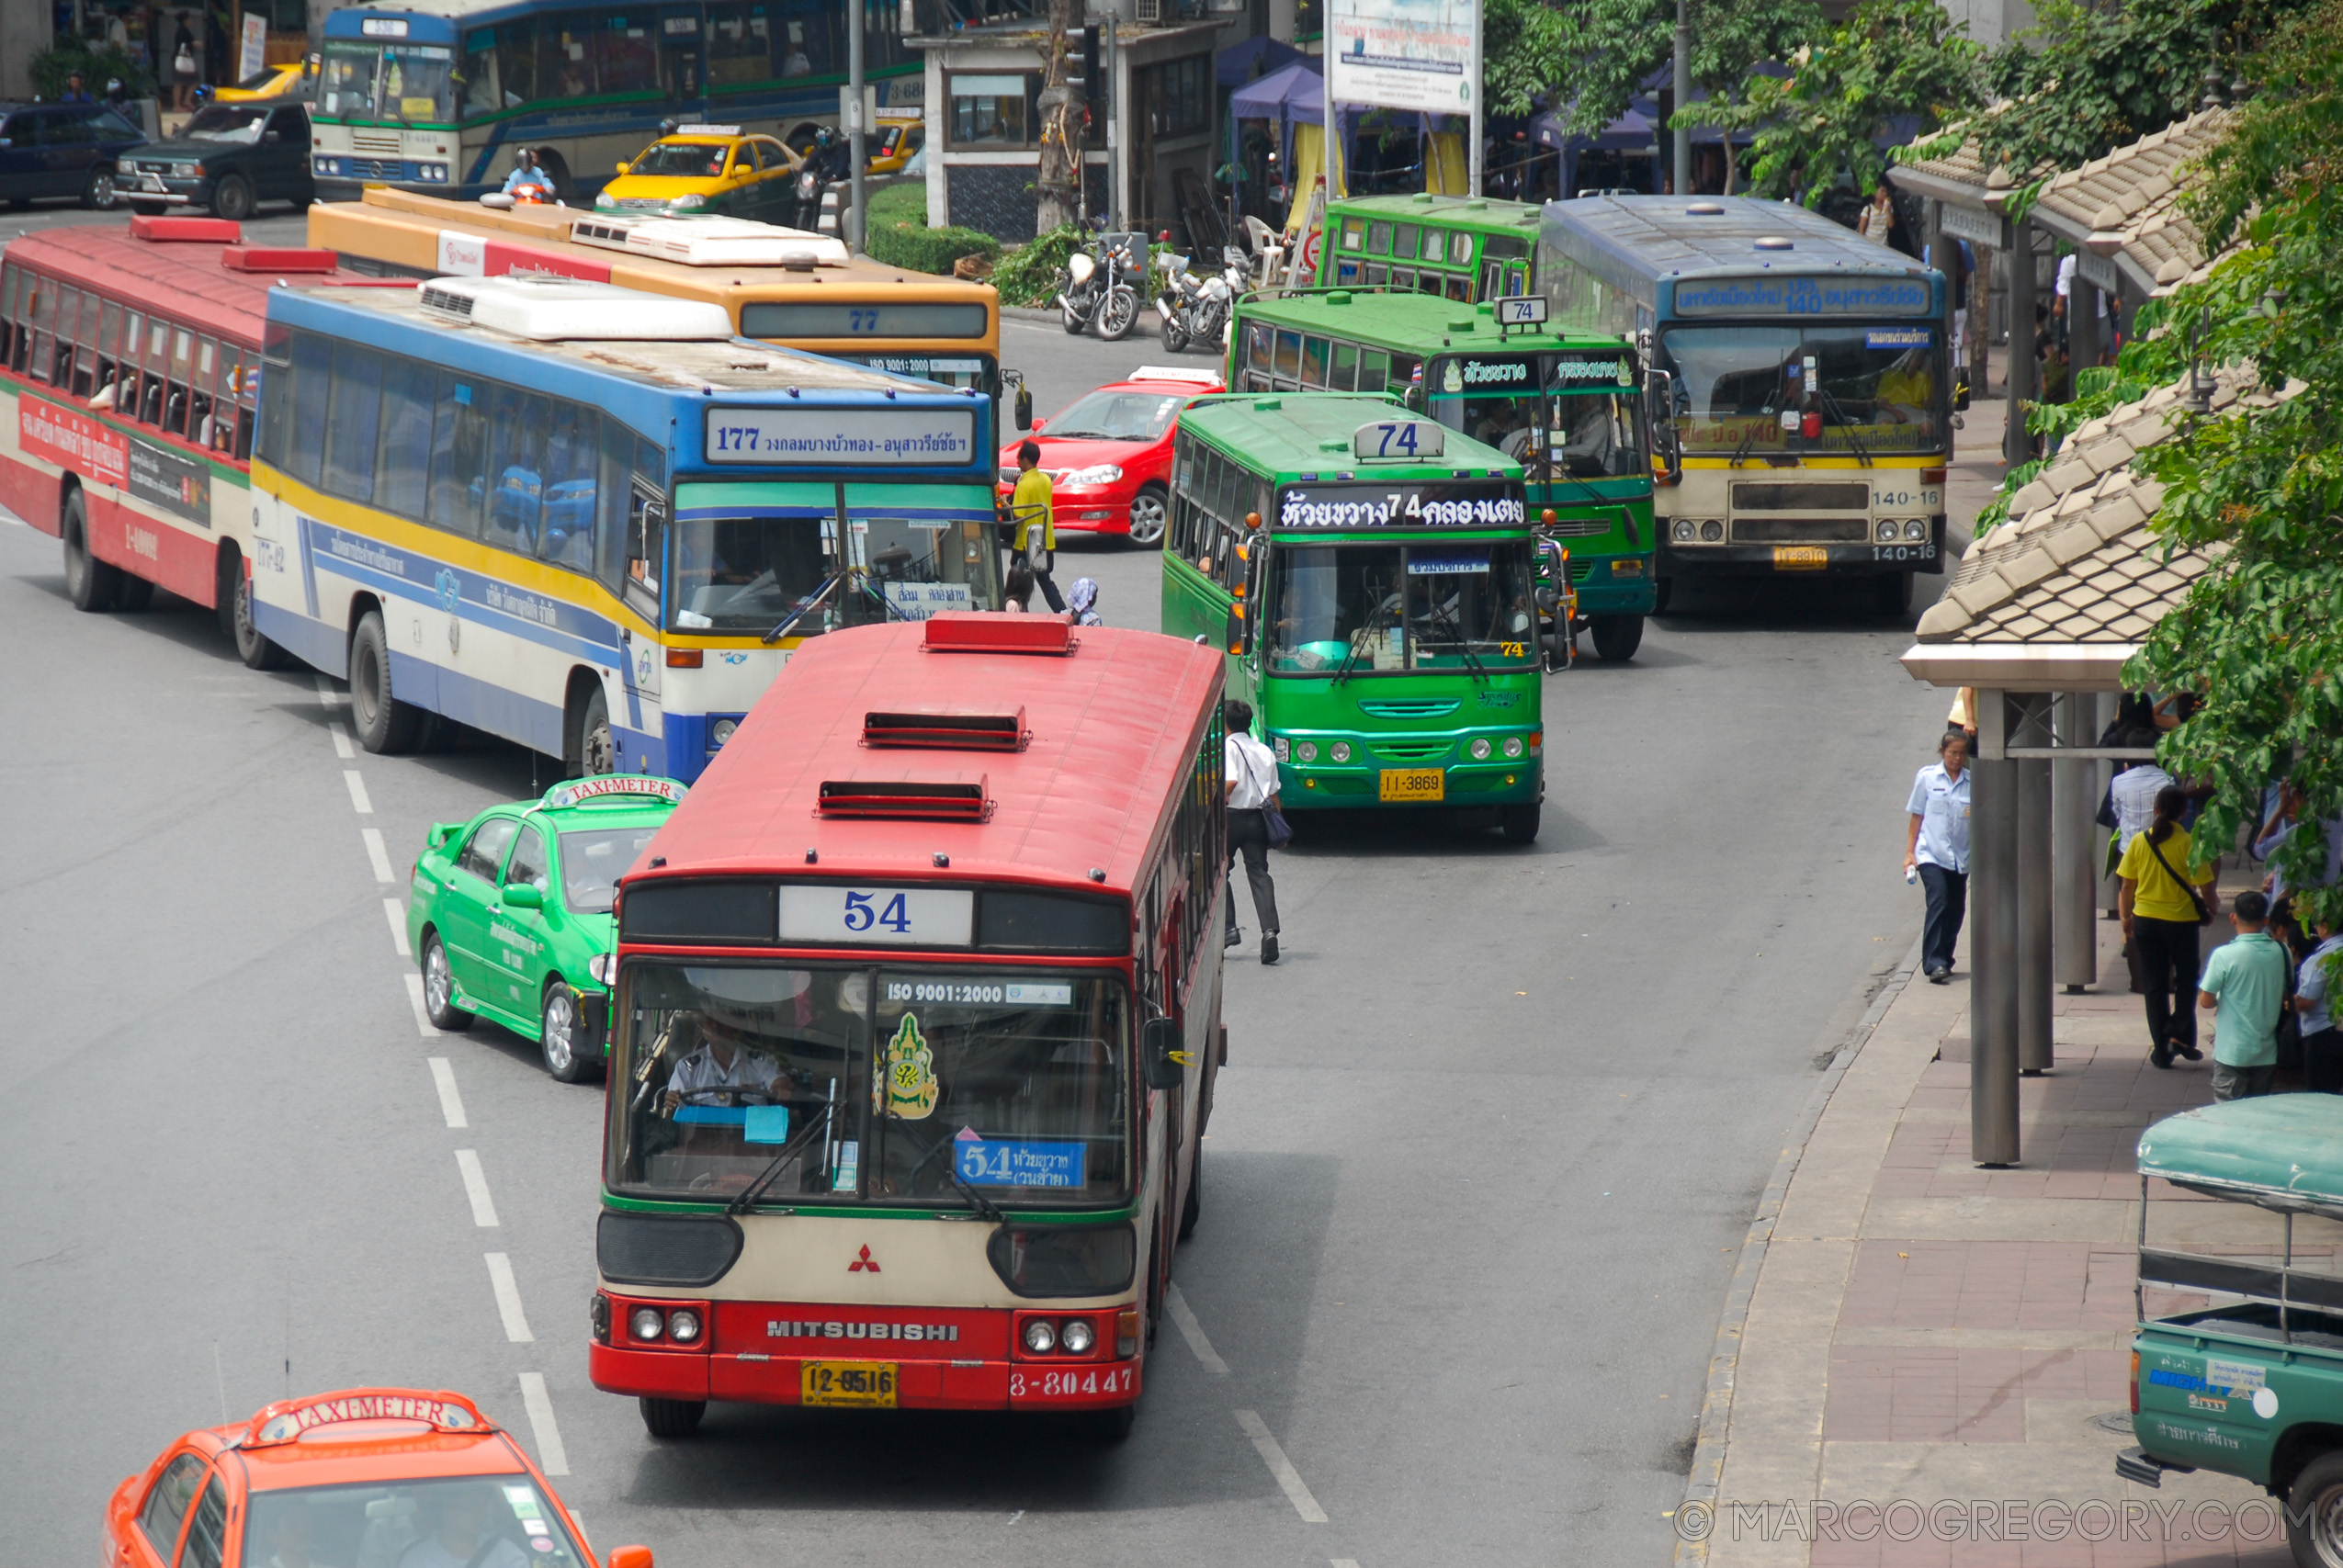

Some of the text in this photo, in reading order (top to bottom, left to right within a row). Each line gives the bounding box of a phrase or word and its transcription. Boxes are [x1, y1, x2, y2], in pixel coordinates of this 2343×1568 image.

[1514, 303, 1533, 320] 74
[1783, 294, 1822, 314] 140
[849, 310, 879, 331] 77
[869, 358, 929, 372] ISO 9001:2000
[1464, 360, 1618, 383] ห้วยขวาง คลองเตย
[717, 427, 760, 450] 177
[1378, 423, 1418, 457] 74
[1281, 491, 1388, 526] ห้วยขวาง
[1422, 499, 1525, 525] คลองเตย
[1873, 491, 1939, 505] 140-16
[1873, 546, 1936, 561] 140-16
[1500, 641, 1524, 658] 74
[570, 778, 672, 800] TAXI-METER
[1386, 775, 1440, 792] 11-3869
[844, 891, 911, 933] 54
[888, 983, 1002, 1003] ISO 9001:2000
[963, 1145, 1069, 1180] 54 ห้วยขวาง
[767, 1321, 958, 1341] MITSUBISHI
[1010, 1367, 1132, 1396] 8-80447
[289, 1396, 443, 1429] TAXI-METER
